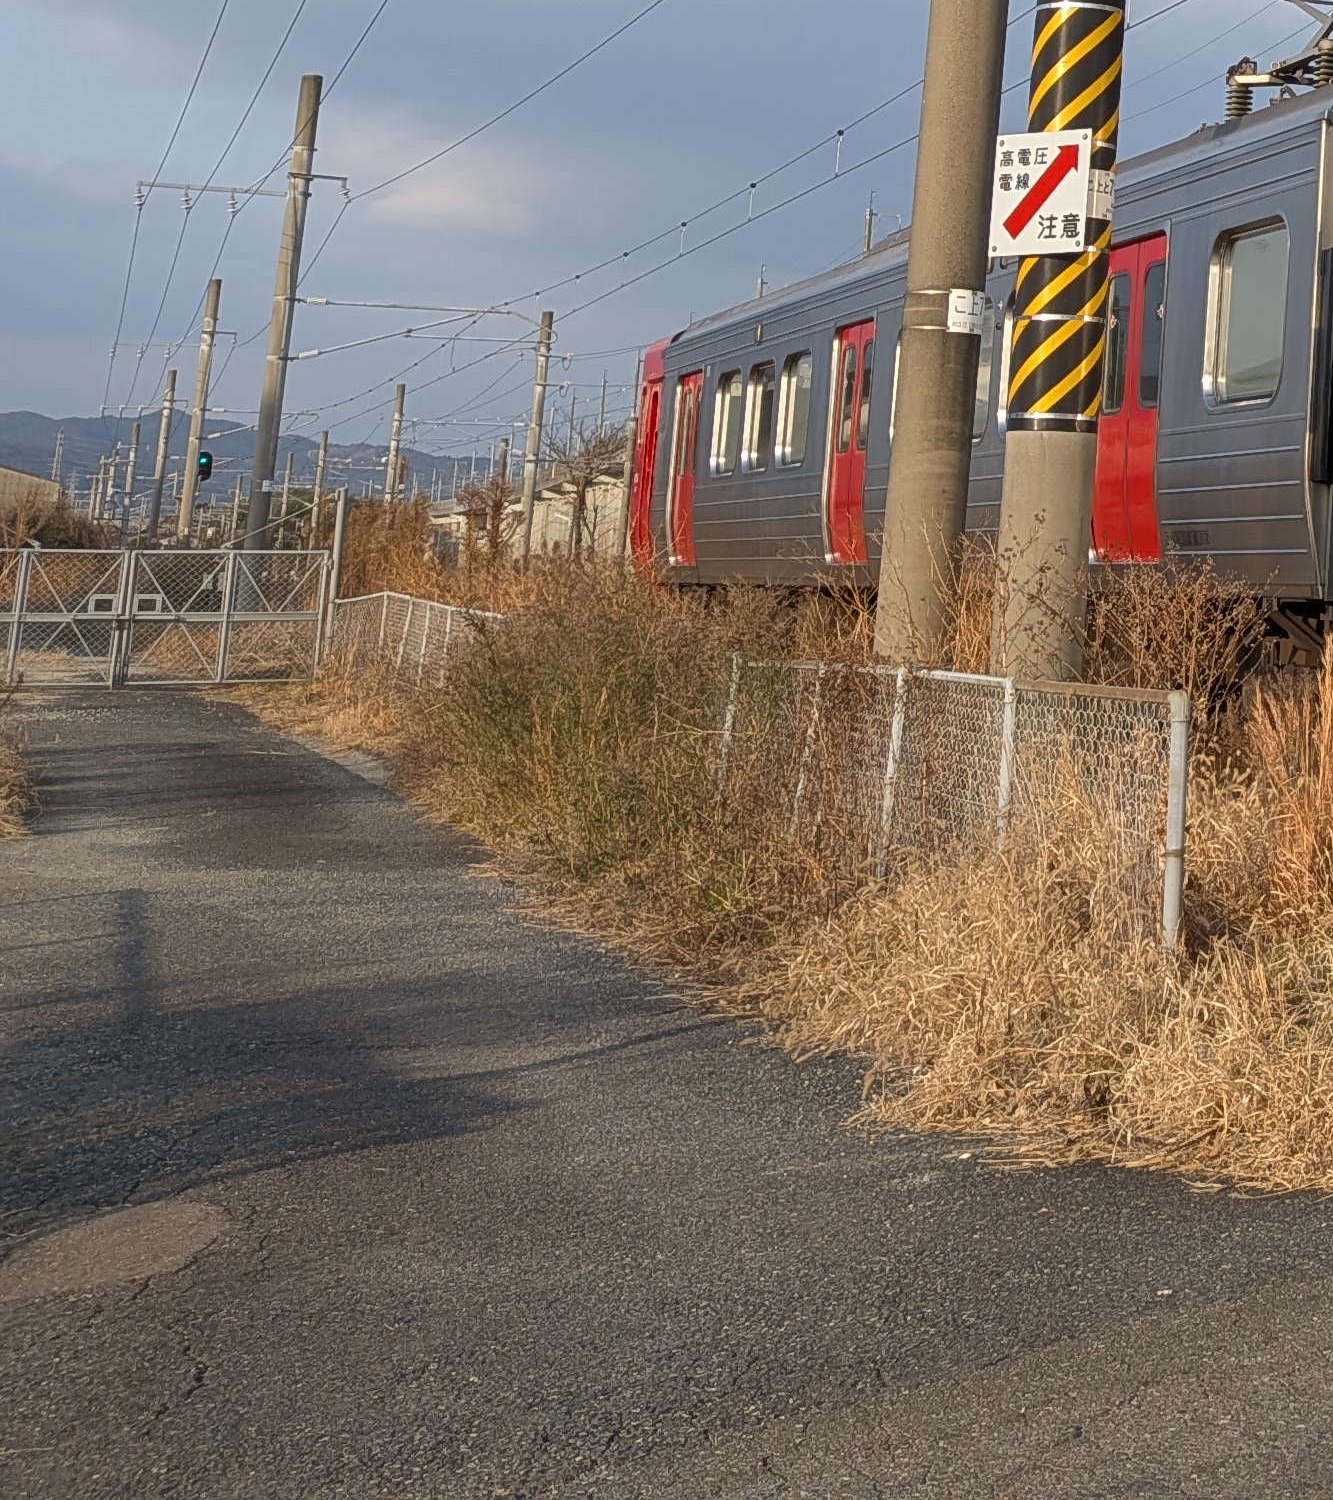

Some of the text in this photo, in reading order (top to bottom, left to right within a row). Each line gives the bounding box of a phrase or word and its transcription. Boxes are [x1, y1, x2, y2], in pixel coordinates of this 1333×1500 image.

[1000, 147, 1048, 167] 高電圧
[999, 172, 1030, 191] 電線
[1037, 213, 1081, 239] 注意
